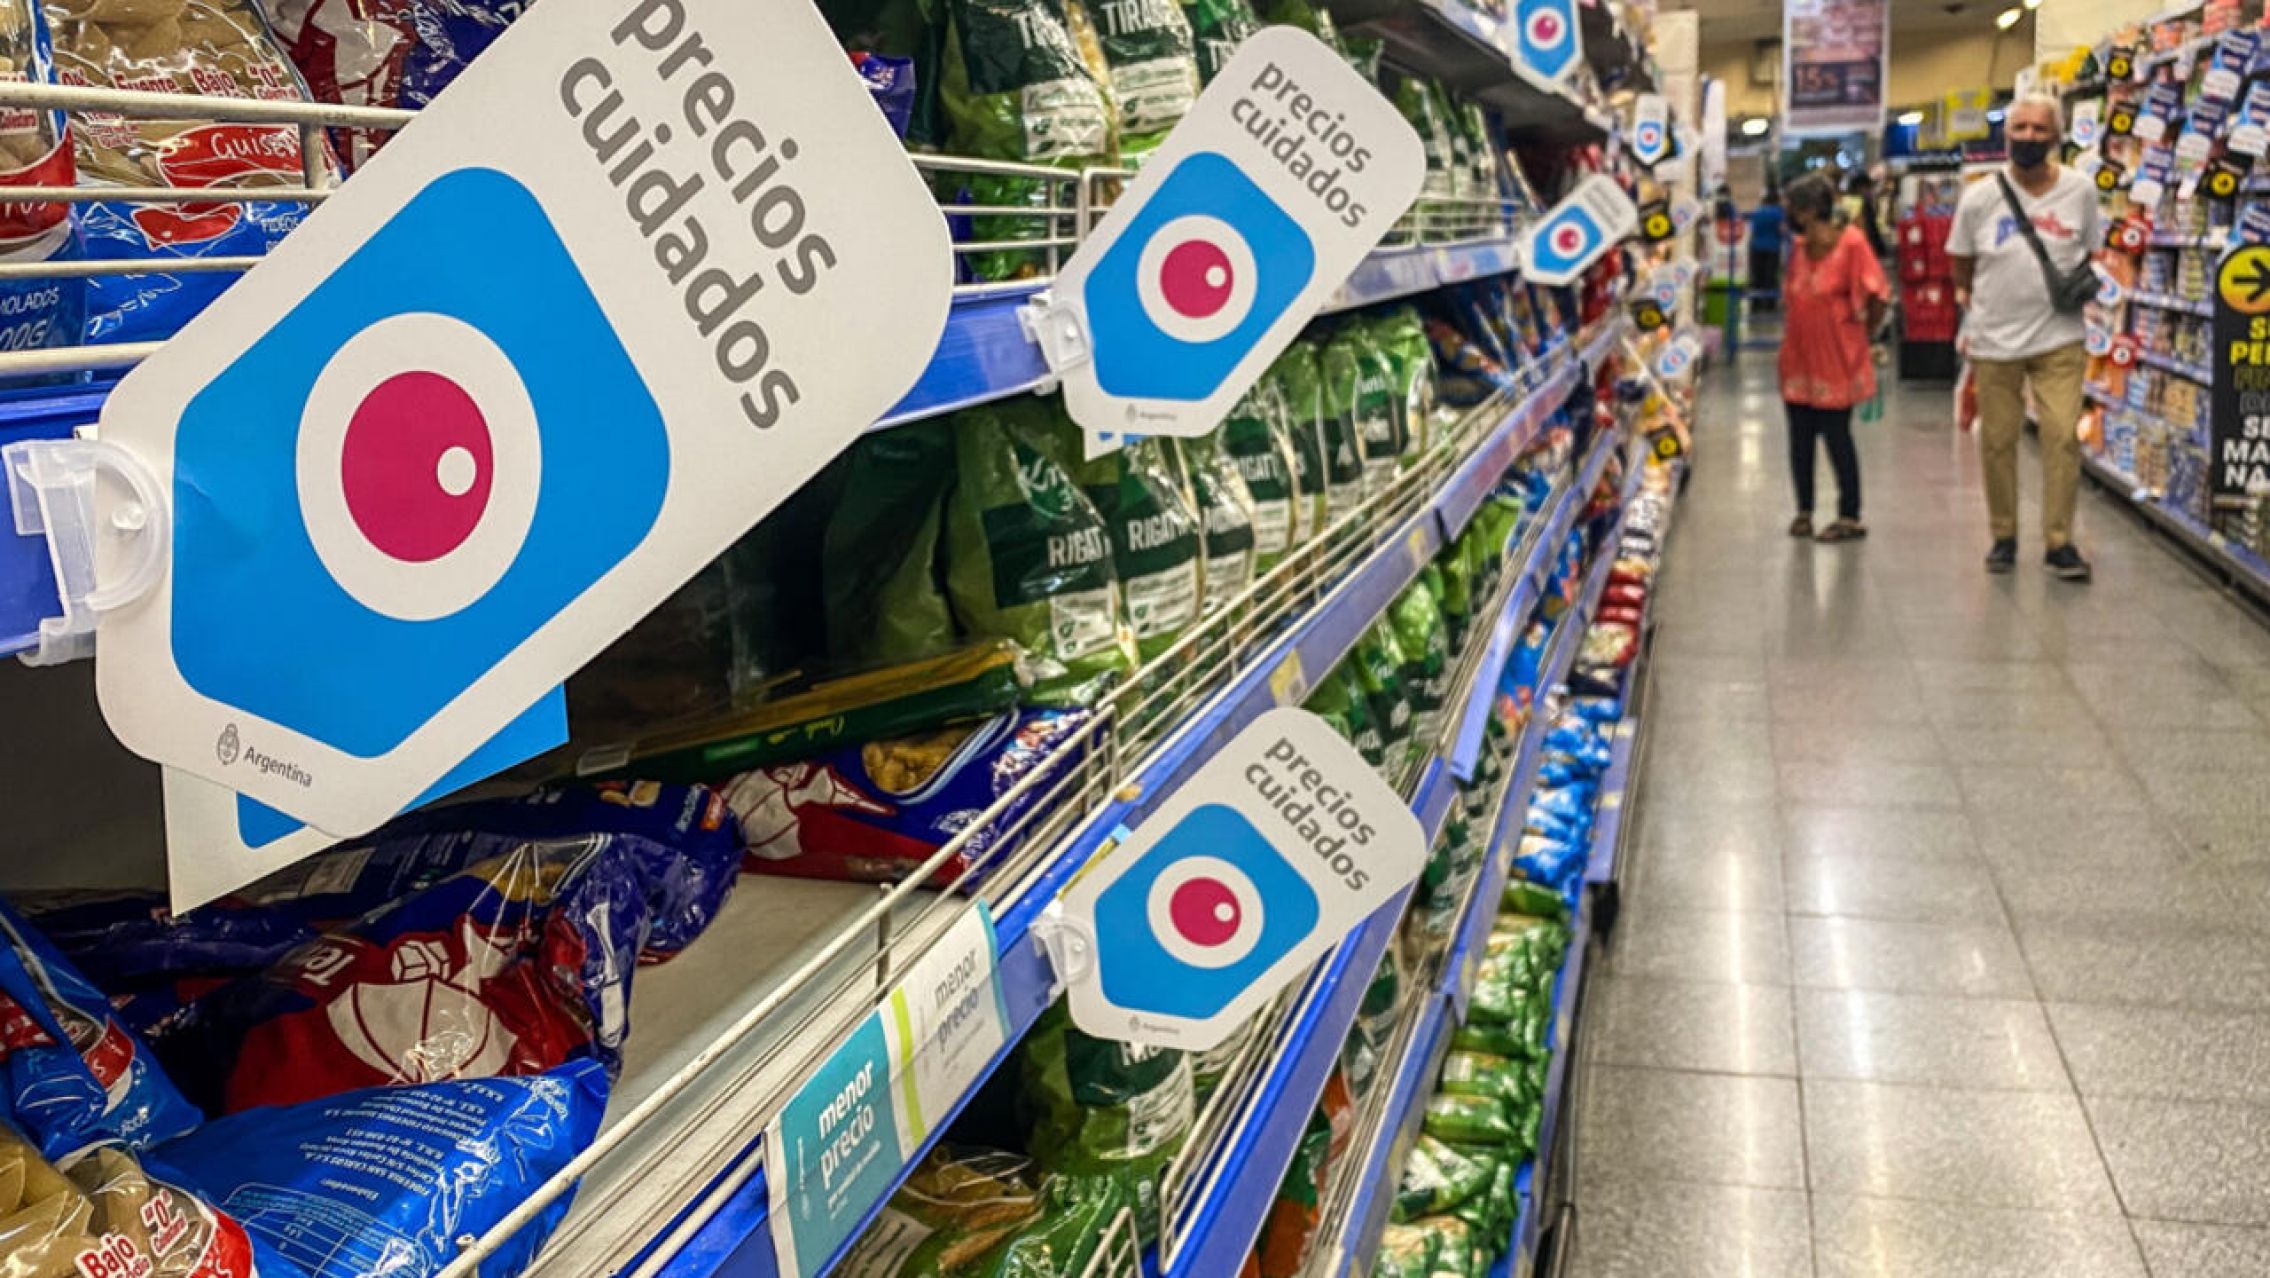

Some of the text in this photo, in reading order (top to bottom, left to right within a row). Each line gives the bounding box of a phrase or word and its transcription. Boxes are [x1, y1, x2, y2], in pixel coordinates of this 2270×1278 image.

[610, 0, 837, 295] precios
[1231, 98, 1368, 228] cuidados
[1251, 61, 1372, 173] precios
[560, 57, 800, 429] cuidados
[242, 745, 313, 788] Argentina
[1264, 737, 1376, 845] precios
[1245, 762, 1370, 892] cuidados
[934, 949, 976, 1006] menor
[938, 986, 979, 1053] precio
[818, 1059, 874, 1140] menor
[820, 1104, 874, 1191] precio
